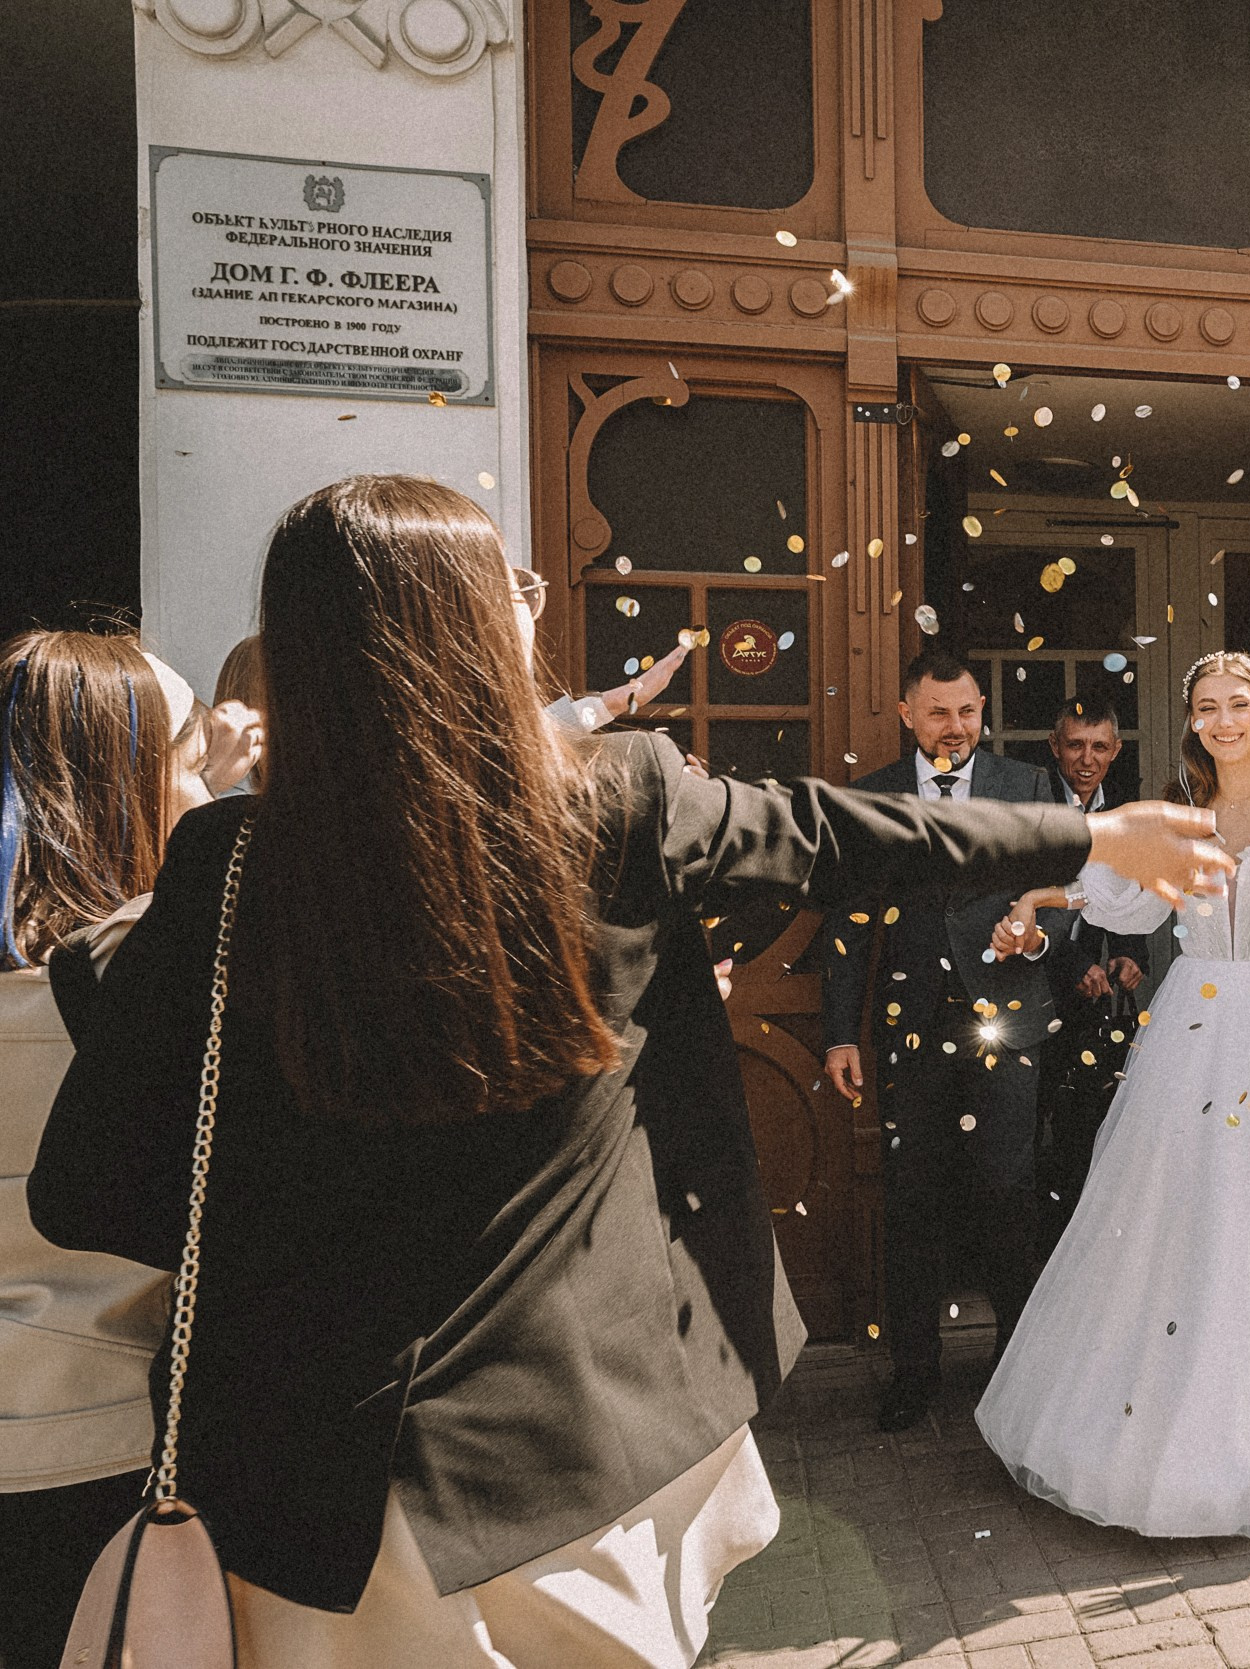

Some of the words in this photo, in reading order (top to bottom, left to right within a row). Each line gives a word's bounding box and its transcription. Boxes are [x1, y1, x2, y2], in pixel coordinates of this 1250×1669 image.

[226, 231, 350, 252] ФЕДЕРАЛЬНОГО
[354, 240, 432, 257] ЗНАЧЕНИЯ
[372, 226, 452, 243] НАСЛЕДИЯ
[210, 262, 274, 285] ДОМ
[280, 266, 299, 285] Г.
[306, 268, 334, 288] Ф.
[340, 270, 440, 294] ФЛЕЕРА
[192, 287, 254, 300] (ЗДАНИЕ
[378, 298, 458, 314] МАГАЗИНА)
[260, 316, 330, 329] ПОСТРОЕНО
[334, 321, 341, 330] В
[346, 322, 366, 331] 1900
[372, 323, 402, 334] ГОДУ
[187, 334, 268, 350] ПОДЛЕЖИТ
